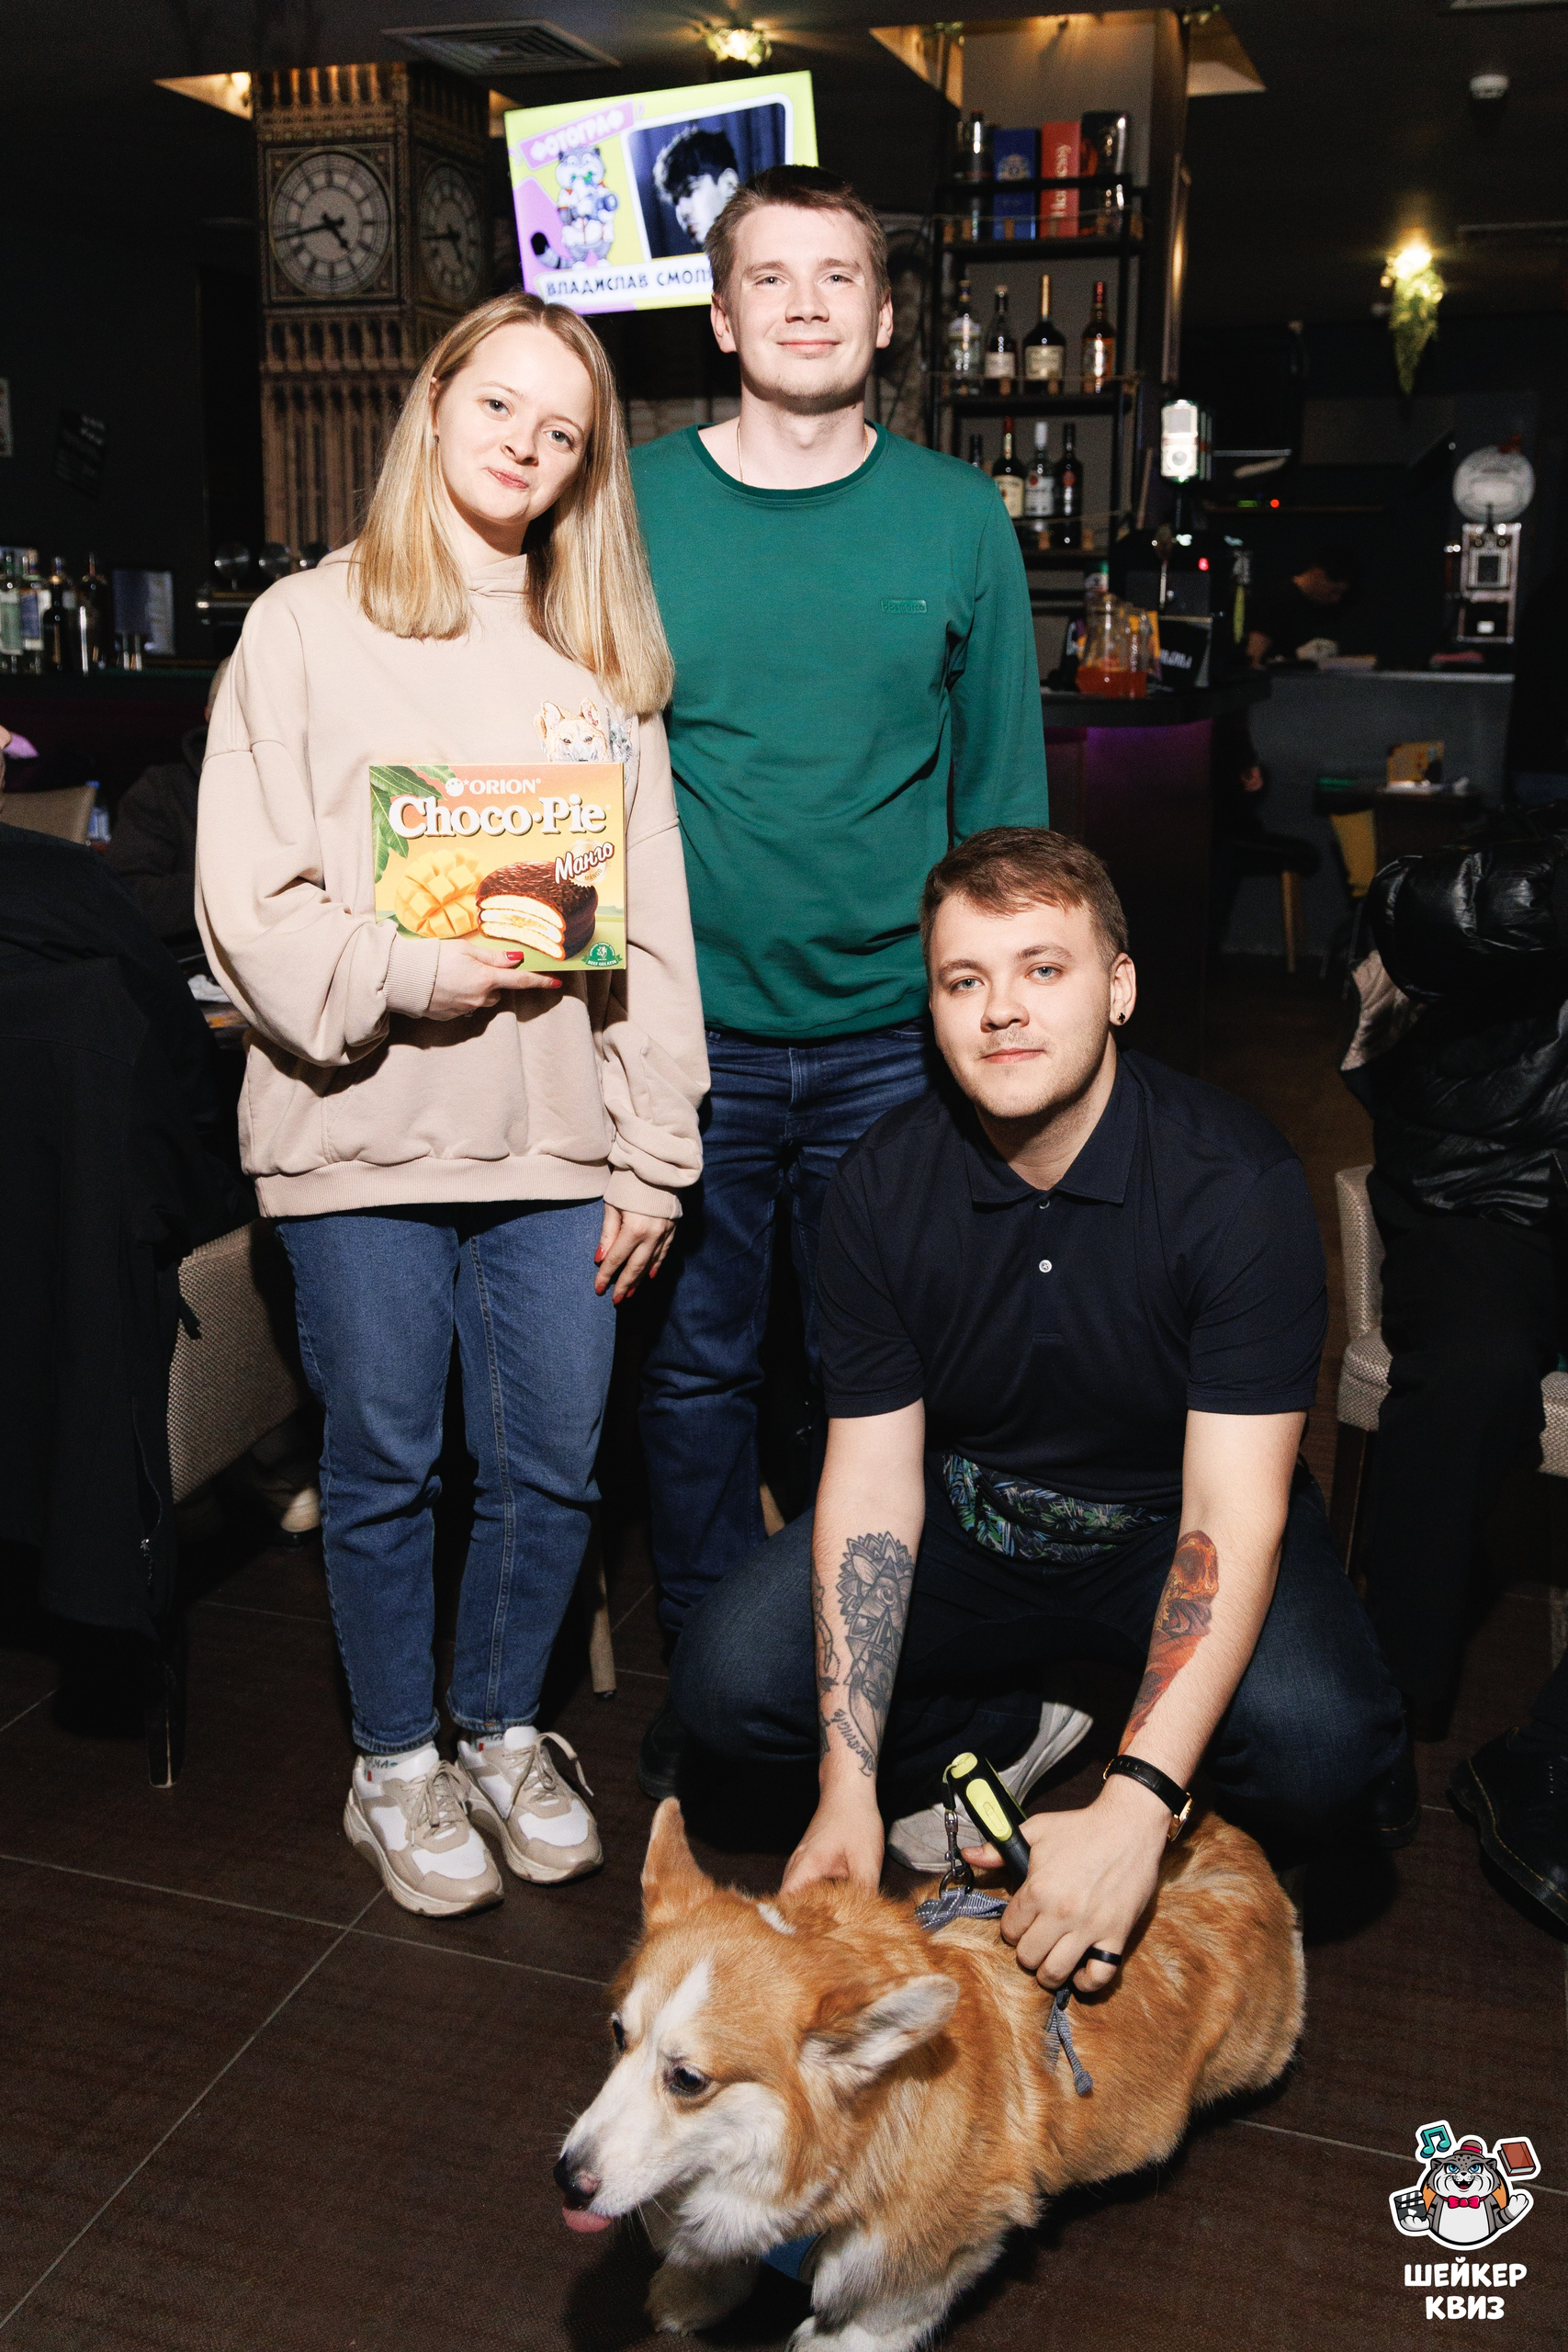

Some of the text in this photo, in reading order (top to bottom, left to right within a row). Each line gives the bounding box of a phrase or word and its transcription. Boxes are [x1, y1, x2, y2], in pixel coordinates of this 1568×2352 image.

[530, 109, 625, 162] ФОТОГРАФ
[546, 275, 649, 297] ВЛАДИСЛАВ
[468, 778, 536, 796] ORION
[554, 842, 615, 885] Манго
[584, 867, 603, 881] MANGO
